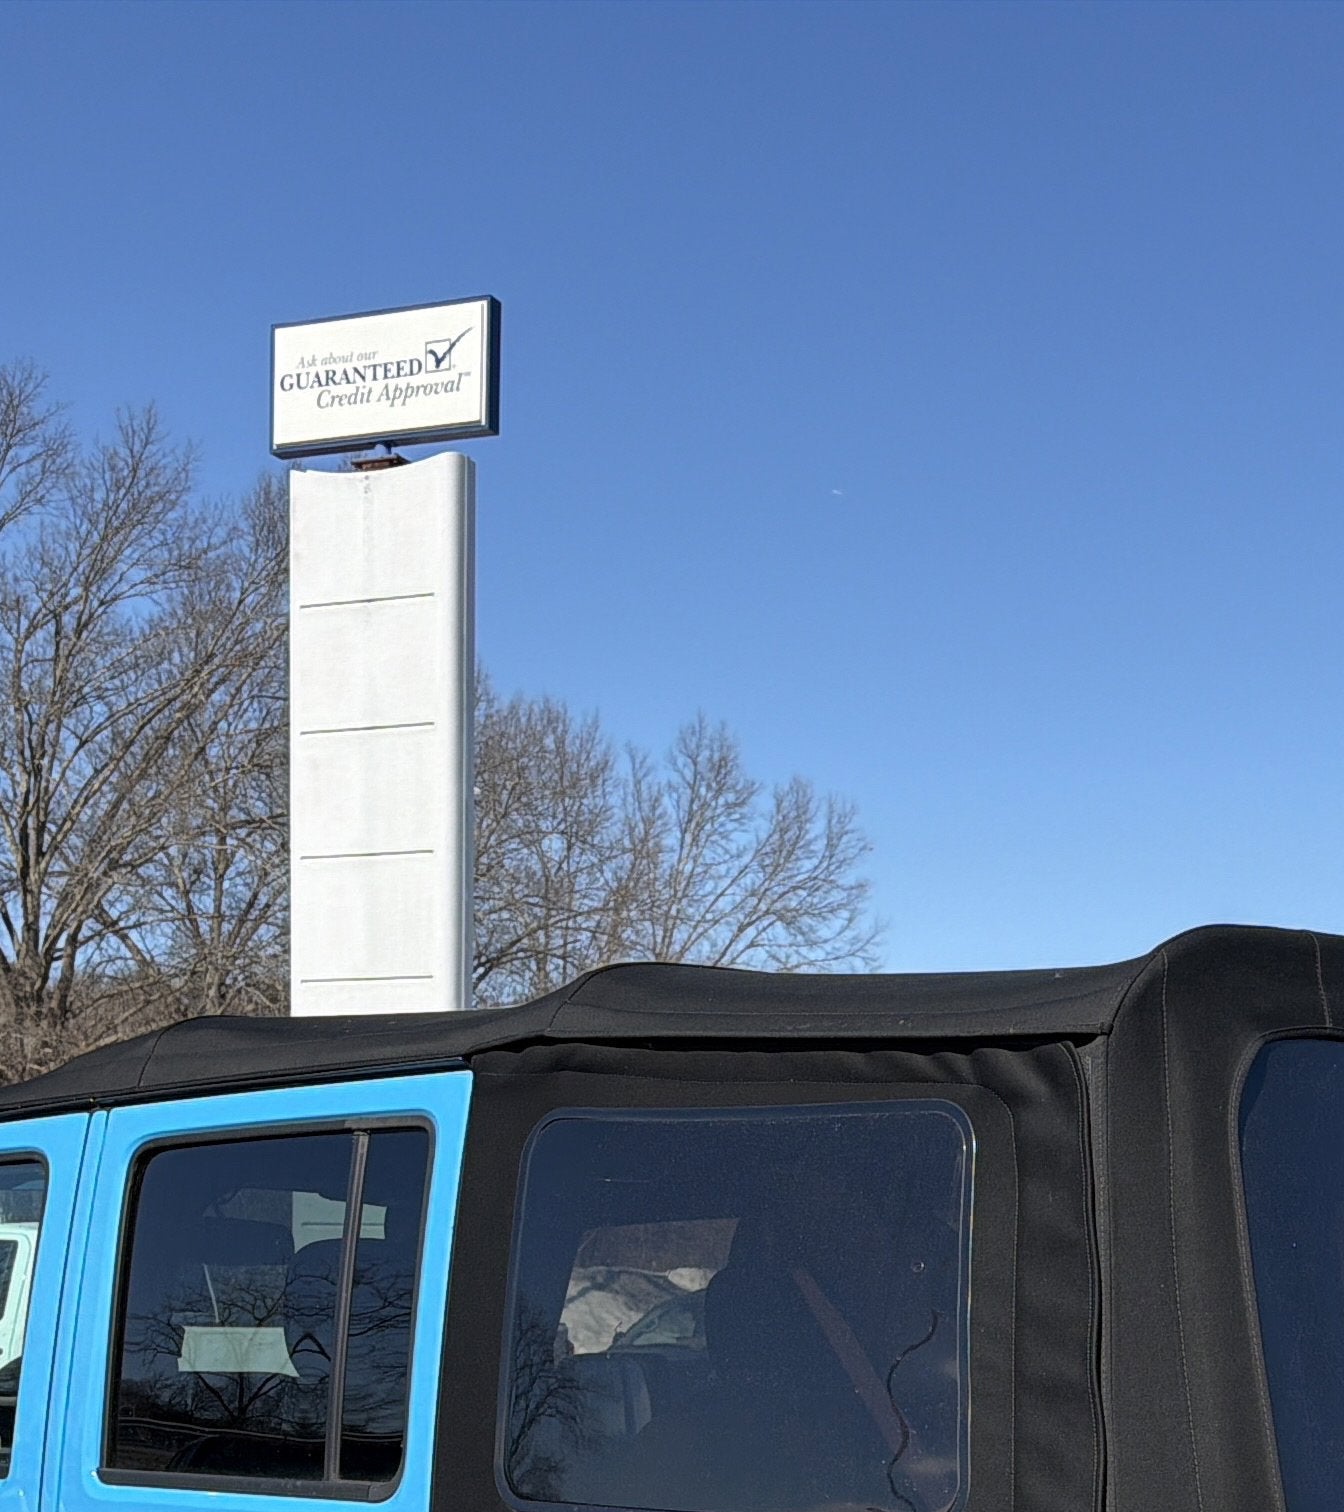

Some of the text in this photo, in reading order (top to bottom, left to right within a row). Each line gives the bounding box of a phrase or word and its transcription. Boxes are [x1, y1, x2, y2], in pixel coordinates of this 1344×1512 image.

[296, 350, 379, 369] Ask about our
[279, 358, 423, 392] GUARANTEED
[316, 386, 374, 409] Credit
